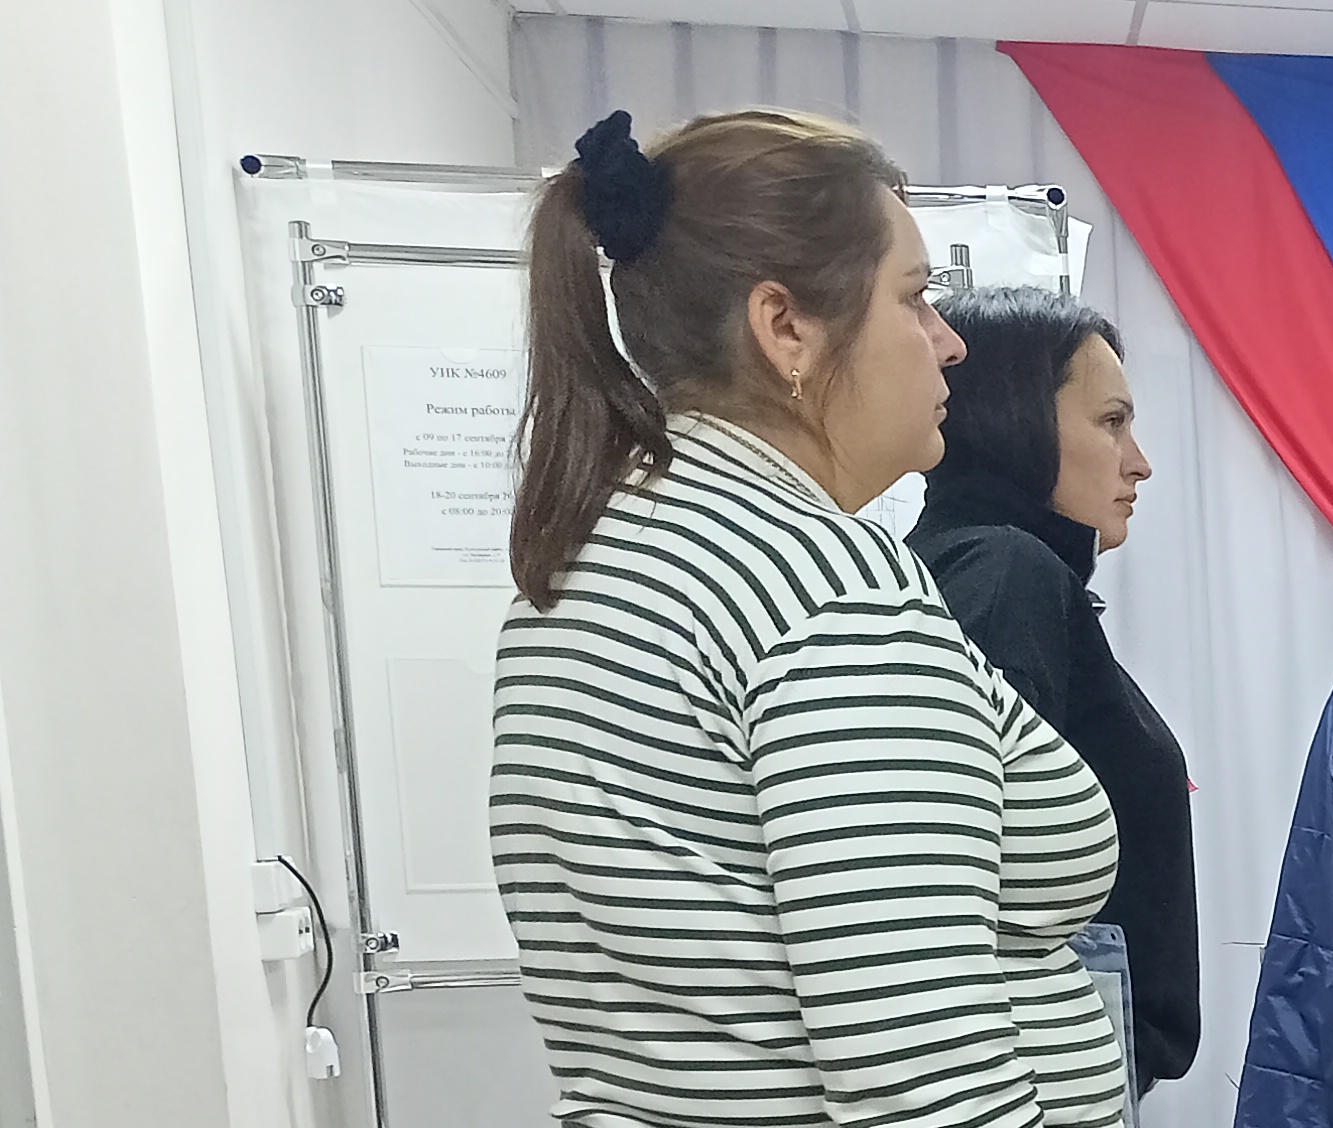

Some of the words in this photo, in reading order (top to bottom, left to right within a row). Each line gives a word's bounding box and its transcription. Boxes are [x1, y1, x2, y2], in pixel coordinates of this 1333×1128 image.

[429, 367, 461, 378] УИК
[464, 368, 507, 379] №4609
[426, 403, 468, 414] Режим
[471, 404, 517, 417] работы
[423, 433, 435, 441] 09
[451, 433, 462, 442] 17
[464, 434, 506, 444] сентября
[458, 491, 500, 502] сентября
